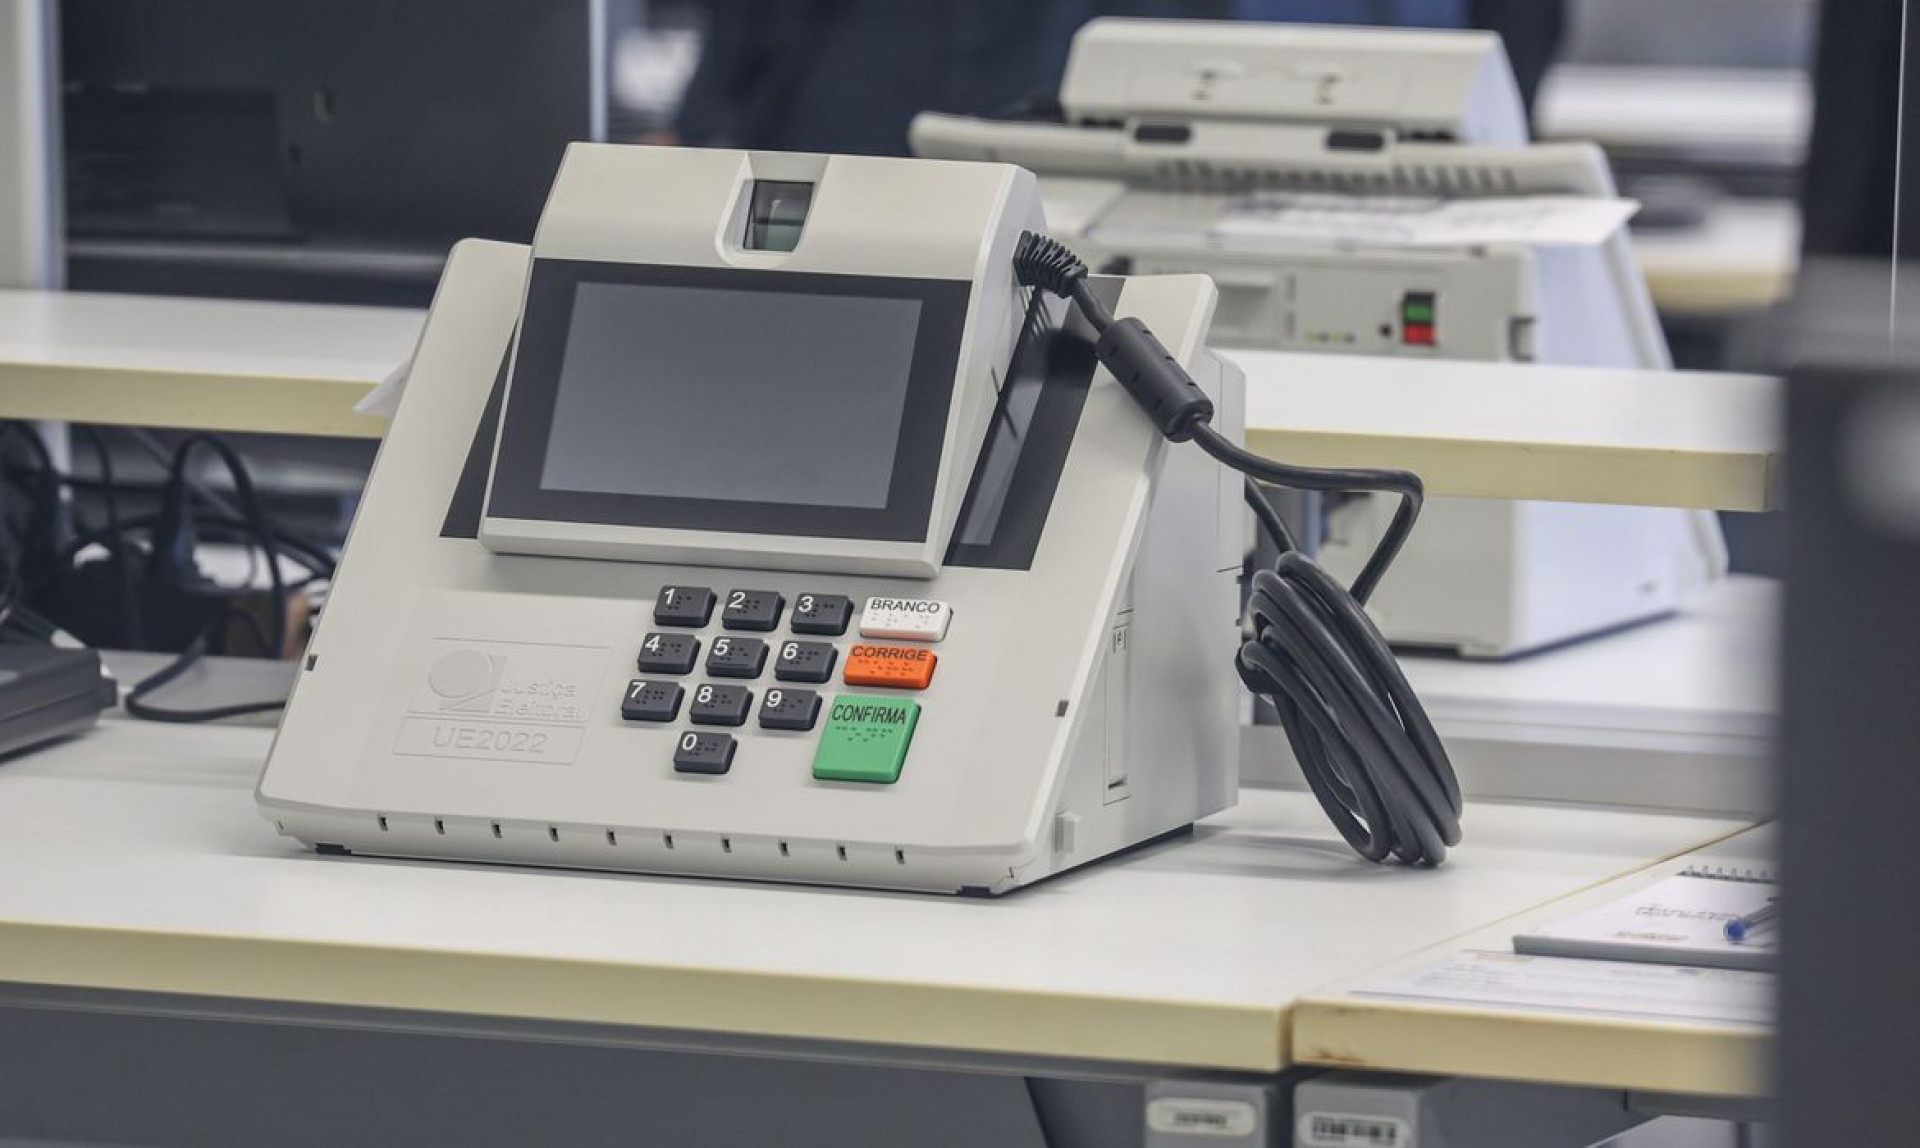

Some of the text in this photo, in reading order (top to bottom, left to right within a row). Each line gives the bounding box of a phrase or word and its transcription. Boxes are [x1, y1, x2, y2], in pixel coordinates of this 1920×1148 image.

[665, 588, 676, 605] 1
[728, 591, 746, 609] 2
[799, 595, 814, 612] 3
[870, 599, 940, 613] BRANCO
[644, 635, 661, 652] 4
[714, 638, 731, 656] 5
[783, 642, 799, 660] 6
[852, 645, 929, 661] CORRIGE
[630, 682, 646, 698] 7
[697, 686, 713, 703] 8
[766, 690, 782, 707] 9
[832, 704, 907, 725] CONFIRMA
[433, 726, 548, 753] UE2022
[682, 734, 697, 751] 0
